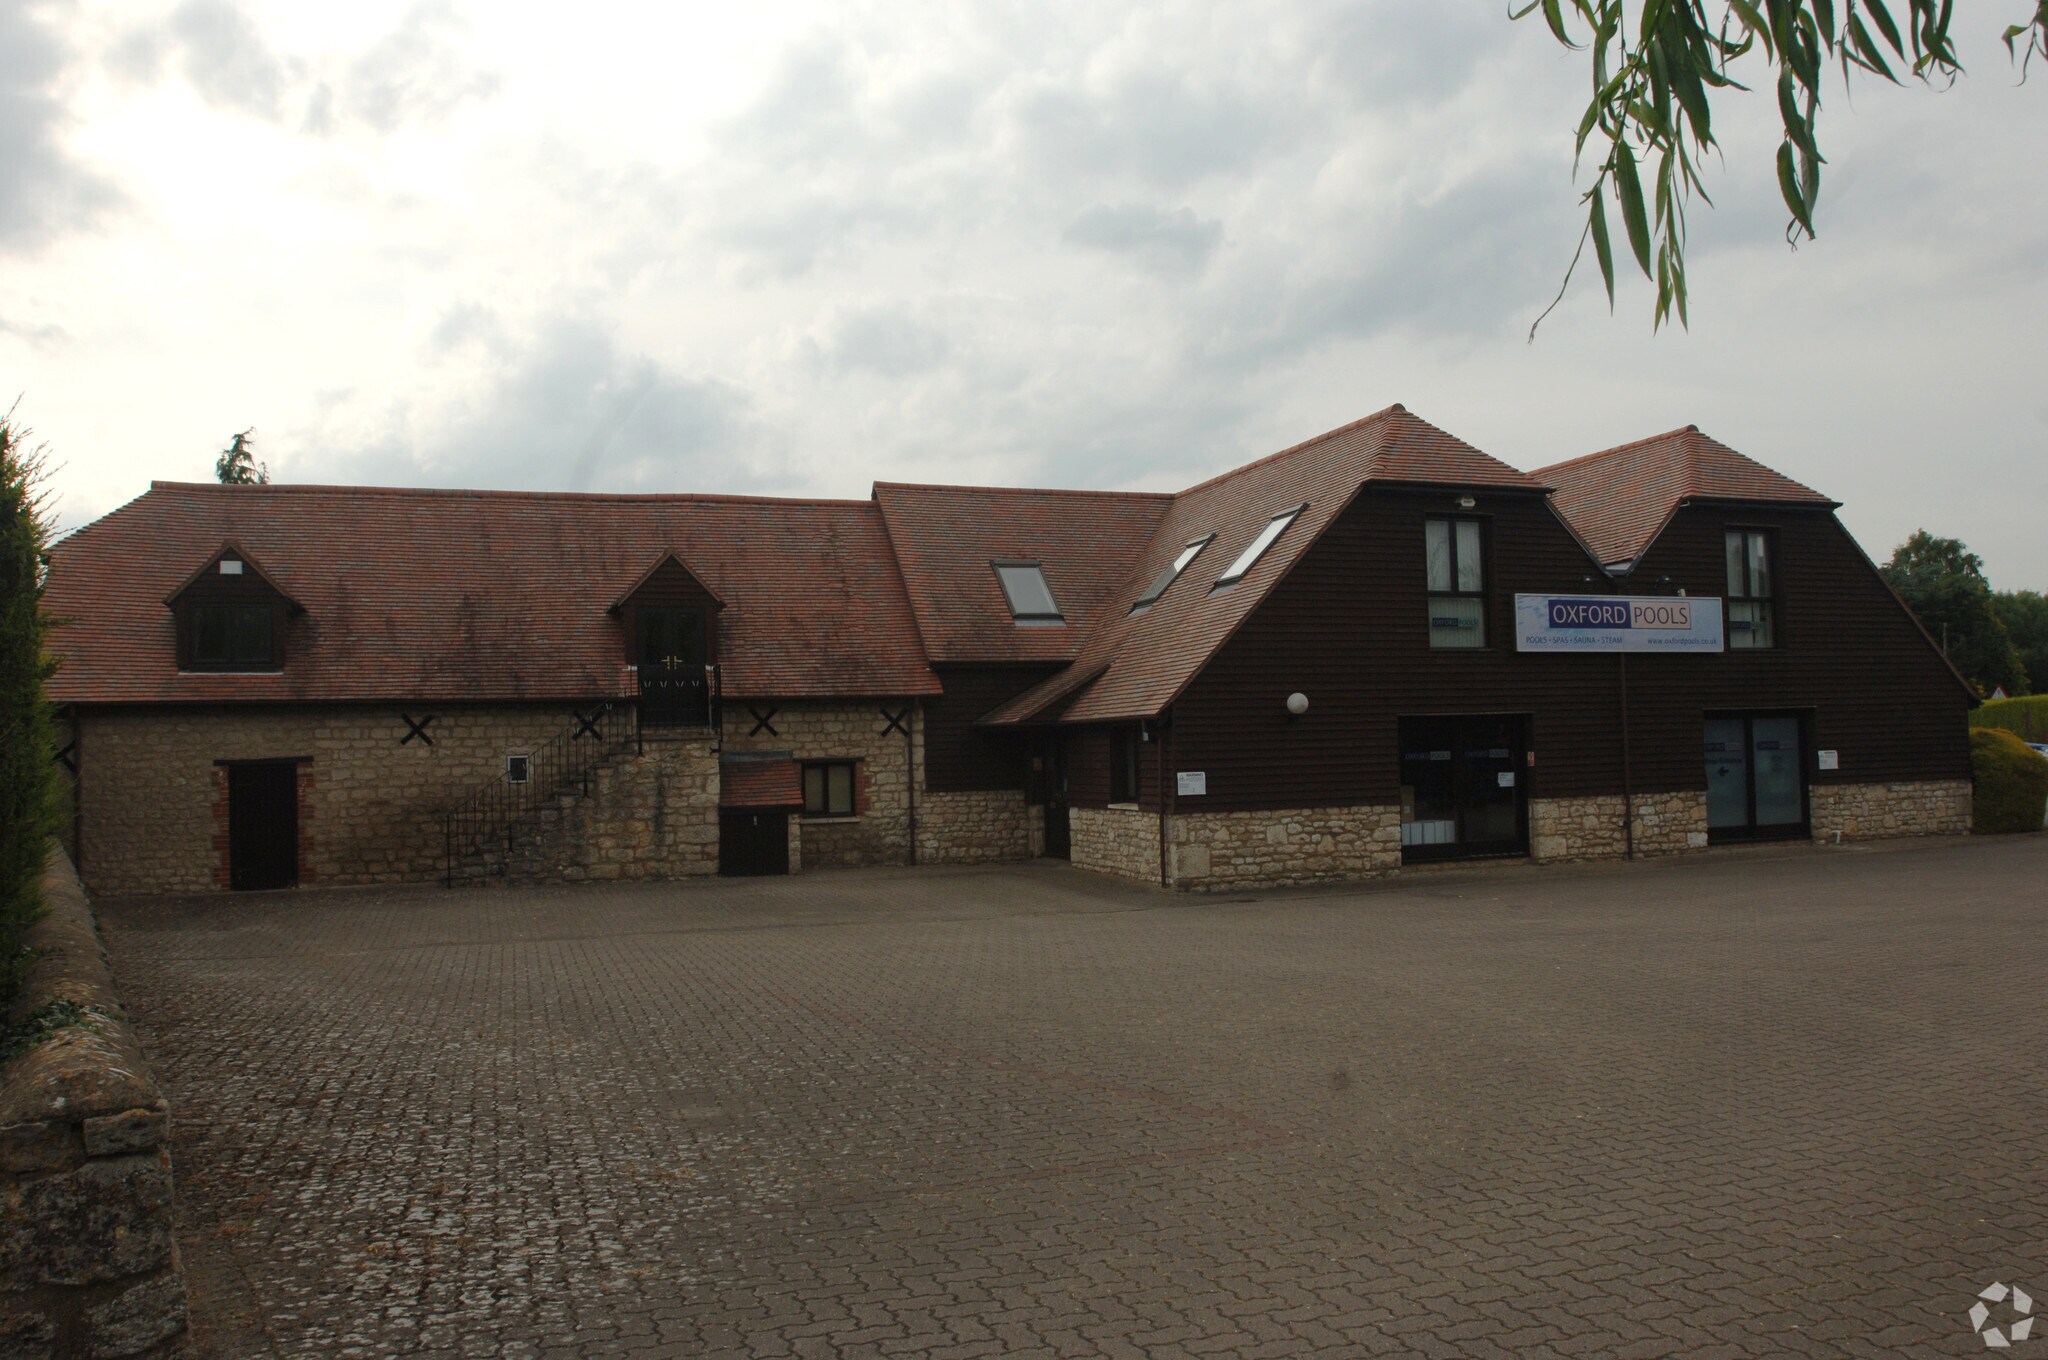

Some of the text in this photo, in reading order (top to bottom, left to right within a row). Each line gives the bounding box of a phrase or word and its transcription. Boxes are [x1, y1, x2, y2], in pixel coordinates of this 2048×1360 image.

[1553, 605, 1688, 625] OXFORD POOLS
[1526, 636, 1622, 645] POOLS SPAS SAUNA STEAM
